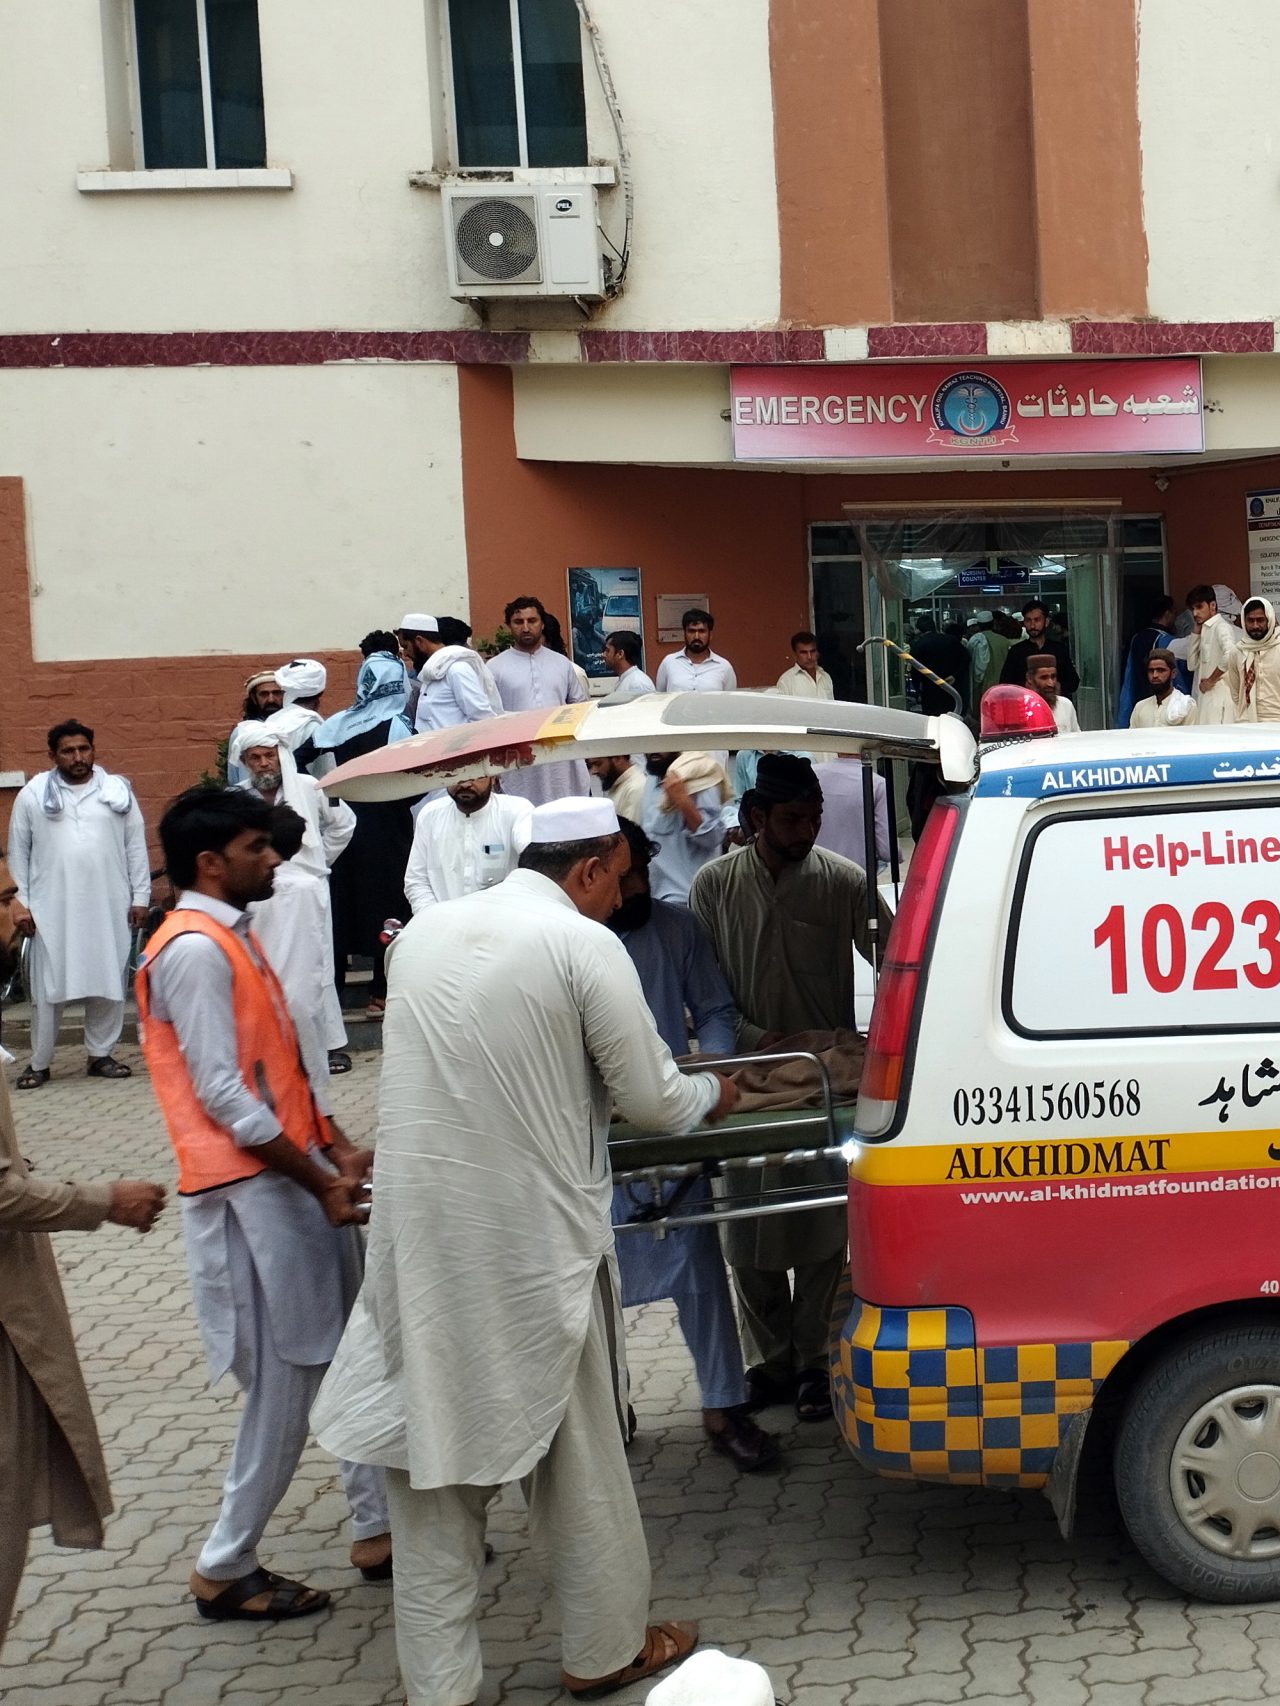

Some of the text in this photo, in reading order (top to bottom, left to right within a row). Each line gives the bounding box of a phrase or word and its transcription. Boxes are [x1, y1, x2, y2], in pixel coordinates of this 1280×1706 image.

[959, 374, 987, 383] TEACHING
[735, 394, 928, 425] EMERGENCY
[1016, 383, 1119, 418] حادثات
[1042, 764, 1171, 790] ALKHIDMAT
[953, 1079, 1141, 1126] 03341560568
[945, 1138, 1171, 1180] ALKHIDMAT
[1260, 1280, 1280, 1294] 40
